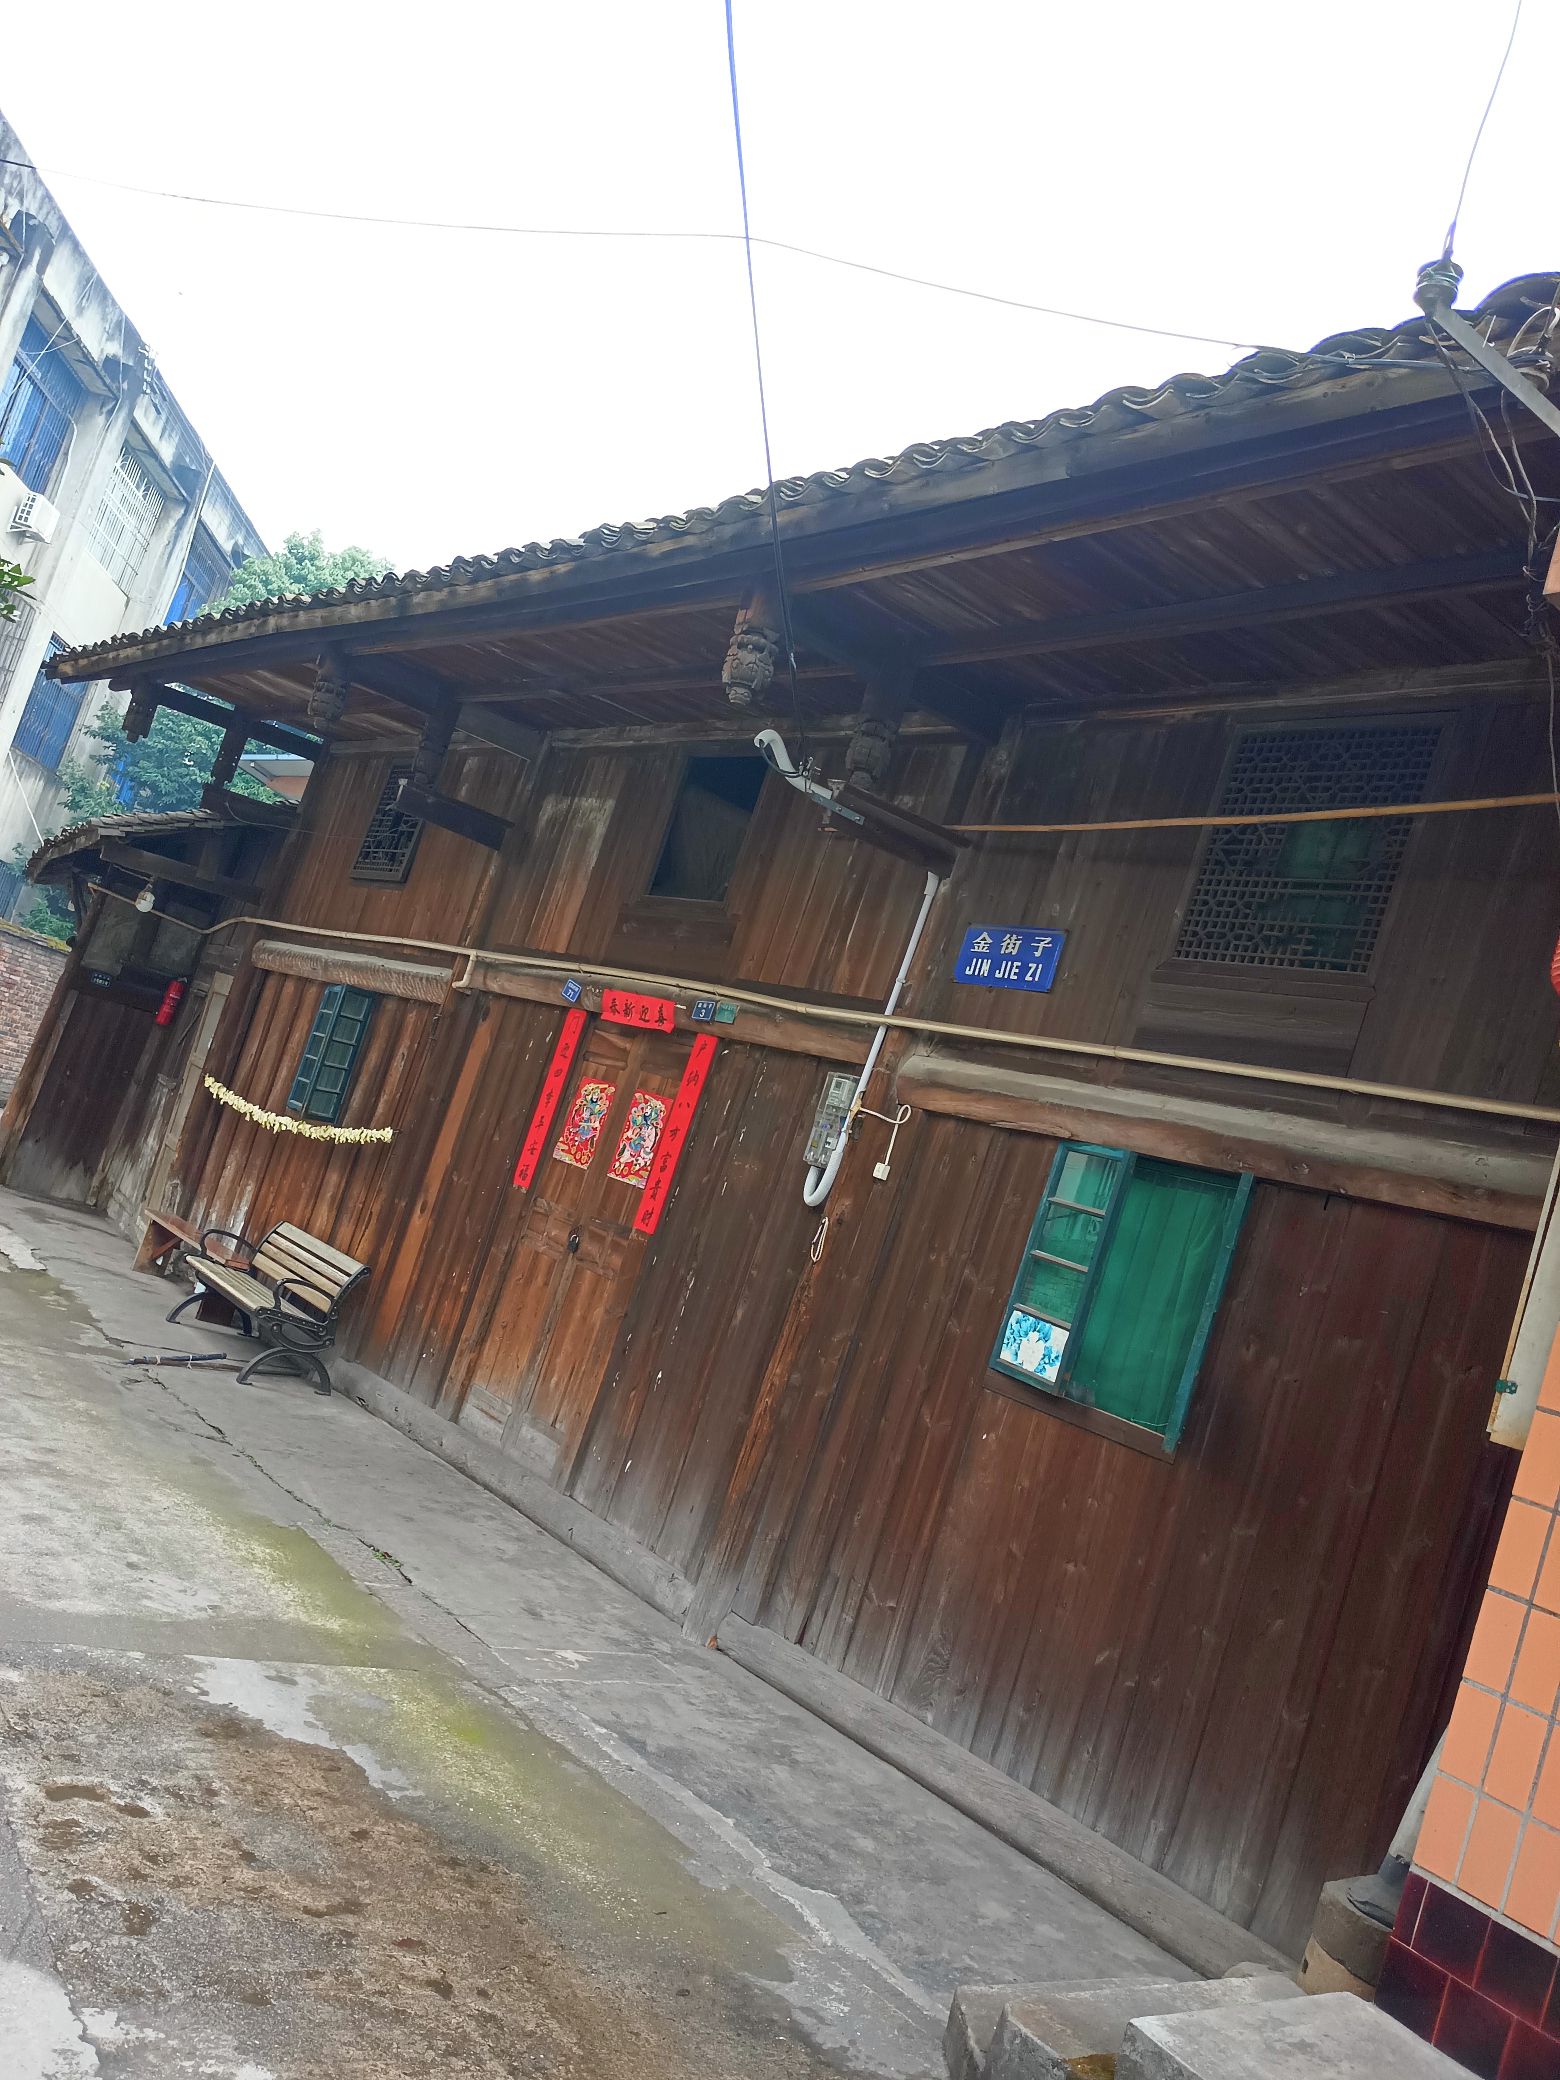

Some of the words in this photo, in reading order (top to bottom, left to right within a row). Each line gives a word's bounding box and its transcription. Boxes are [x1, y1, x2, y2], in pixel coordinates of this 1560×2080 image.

[970, 931, 1053, 958] 金街子
[965, 957, 991, 977] JIN
[994, 960, 1022, 980] JIE
[1025, 963, 1043, 982] ZI
[699, 1009, 706, 1018] 3
